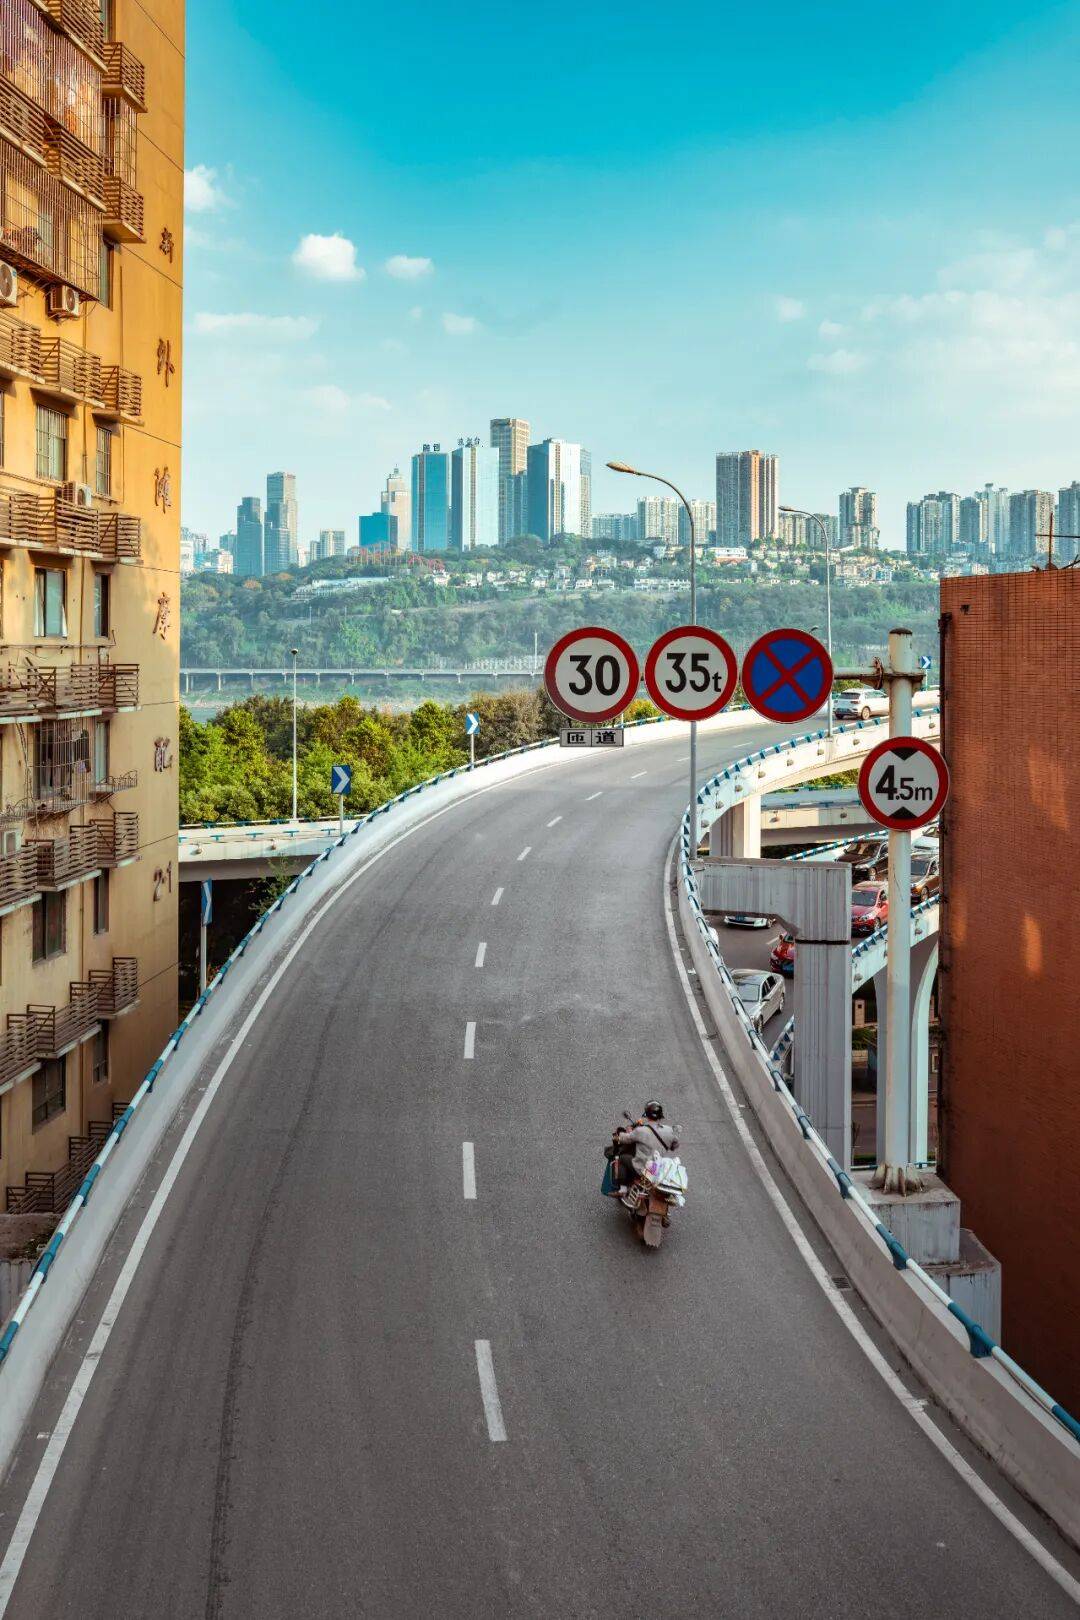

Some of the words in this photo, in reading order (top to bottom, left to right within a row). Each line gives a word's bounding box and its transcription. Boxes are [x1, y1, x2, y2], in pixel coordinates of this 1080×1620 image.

[568, 655, 621, 696] 30
[665, 652, 722, 693] 35t
[567, 730, 616, 744] 匝道
[875, 764, 933, 801] 4.5m
